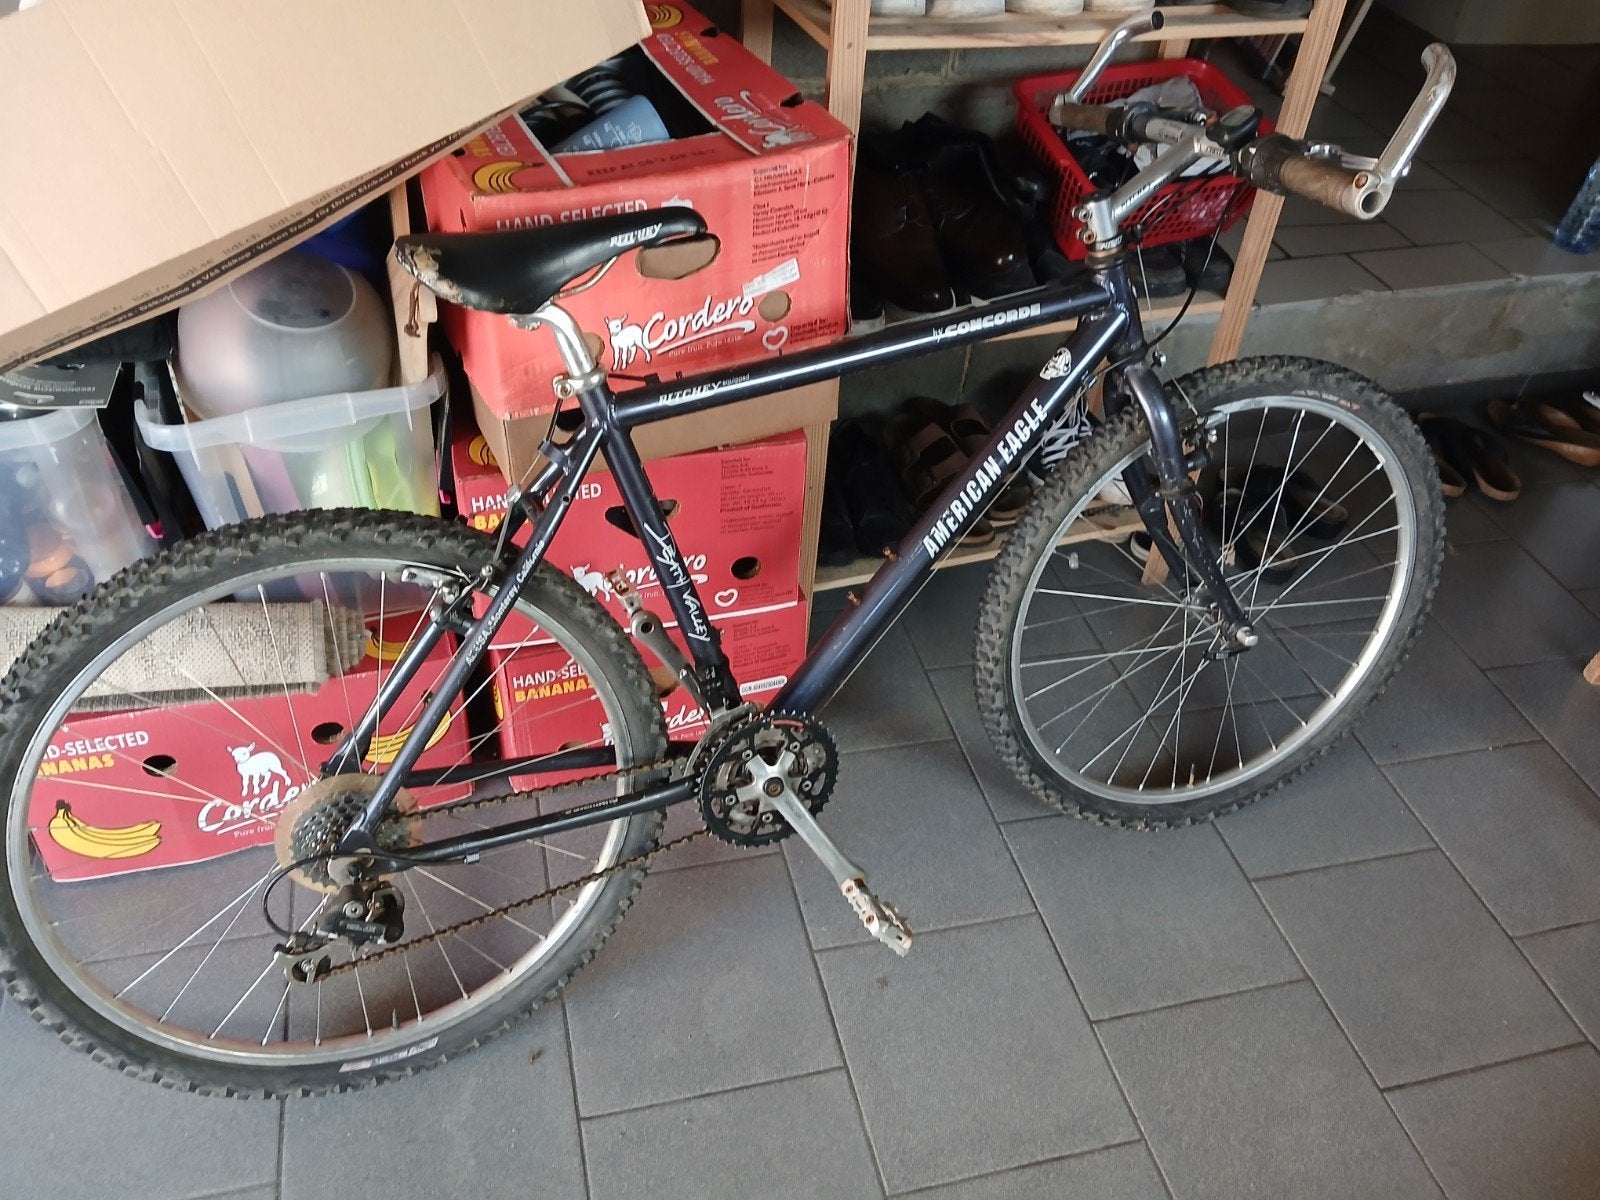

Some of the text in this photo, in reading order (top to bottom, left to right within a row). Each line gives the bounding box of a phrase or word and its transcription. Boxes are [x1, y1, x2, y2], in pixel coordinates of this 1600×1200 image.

[642, 294, 755, 350] Cordero
[944, 302, 1041, 338] CONCORDE
[922, 397, 1049, 559] AMERICAN EAGLE
[682, 586, 711, 642] VALLEY
[513, 663, 585, 689] HAND-SEL
[38, 753, 115, 777] NANAS
[43, 730, 149, 760] D-SELECTED
[197, 780, 309, 833] Corde
